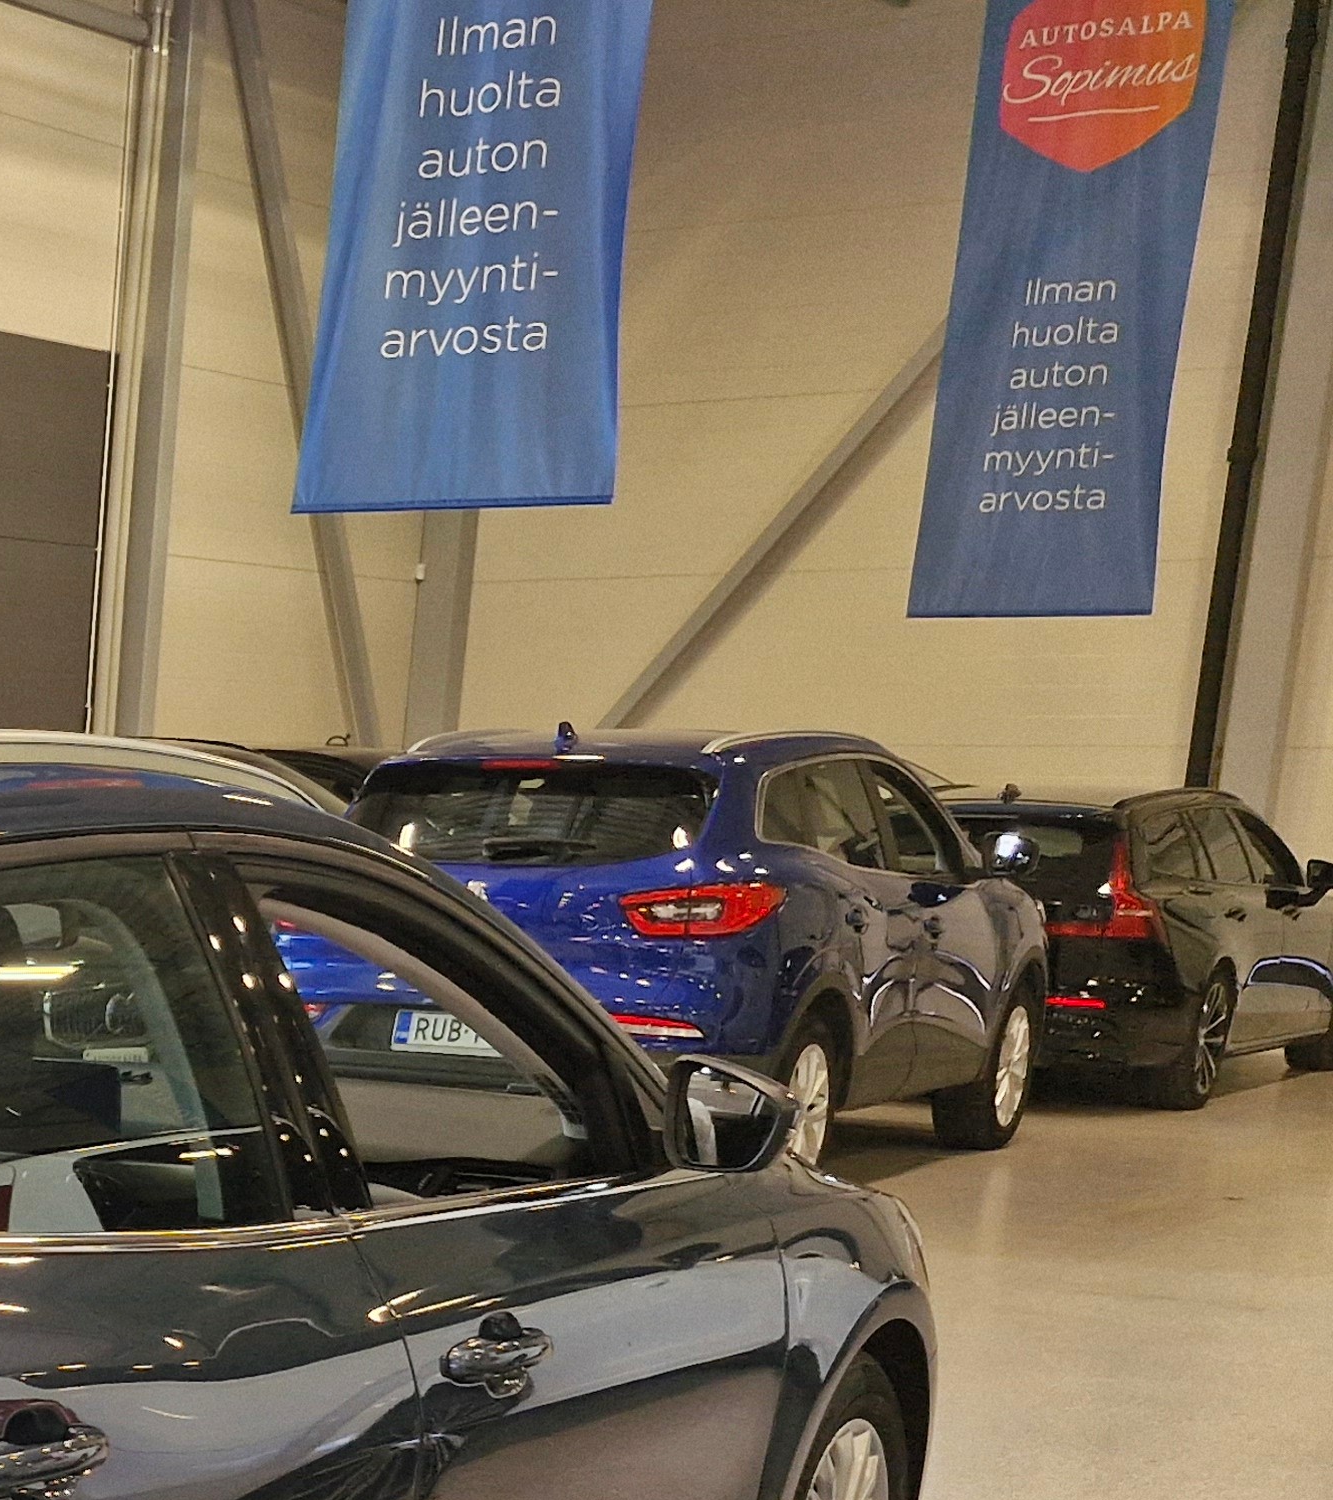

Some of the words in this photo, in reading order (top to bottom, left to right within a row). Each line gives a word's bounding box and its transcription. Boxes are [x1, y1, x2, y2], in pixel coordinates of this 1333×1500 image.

[436, 14, 557, 56] Ilman
[1019, 10, 1194, 49] AUTOSALPA
[419, 70, 562, 118] huolta
[1003, 52, 1197, 105] Sopimus
[418, 138, 548, 179] auton
[392, 198, 560, 248] jälleen-
[385, 252, 559, 305] myynti-
[1025, 277, 1117, 307] Ilman
[380, 316, 548, 359] arvosta
[1011, 316, 1119, 348] huolta
[1009, 360, 1108, 389] auton
[990, 402, 1116, 437] jälleen-
[983, 439, 1115, 476] myynti-
[978, 487, 1106, 514] arvosta
